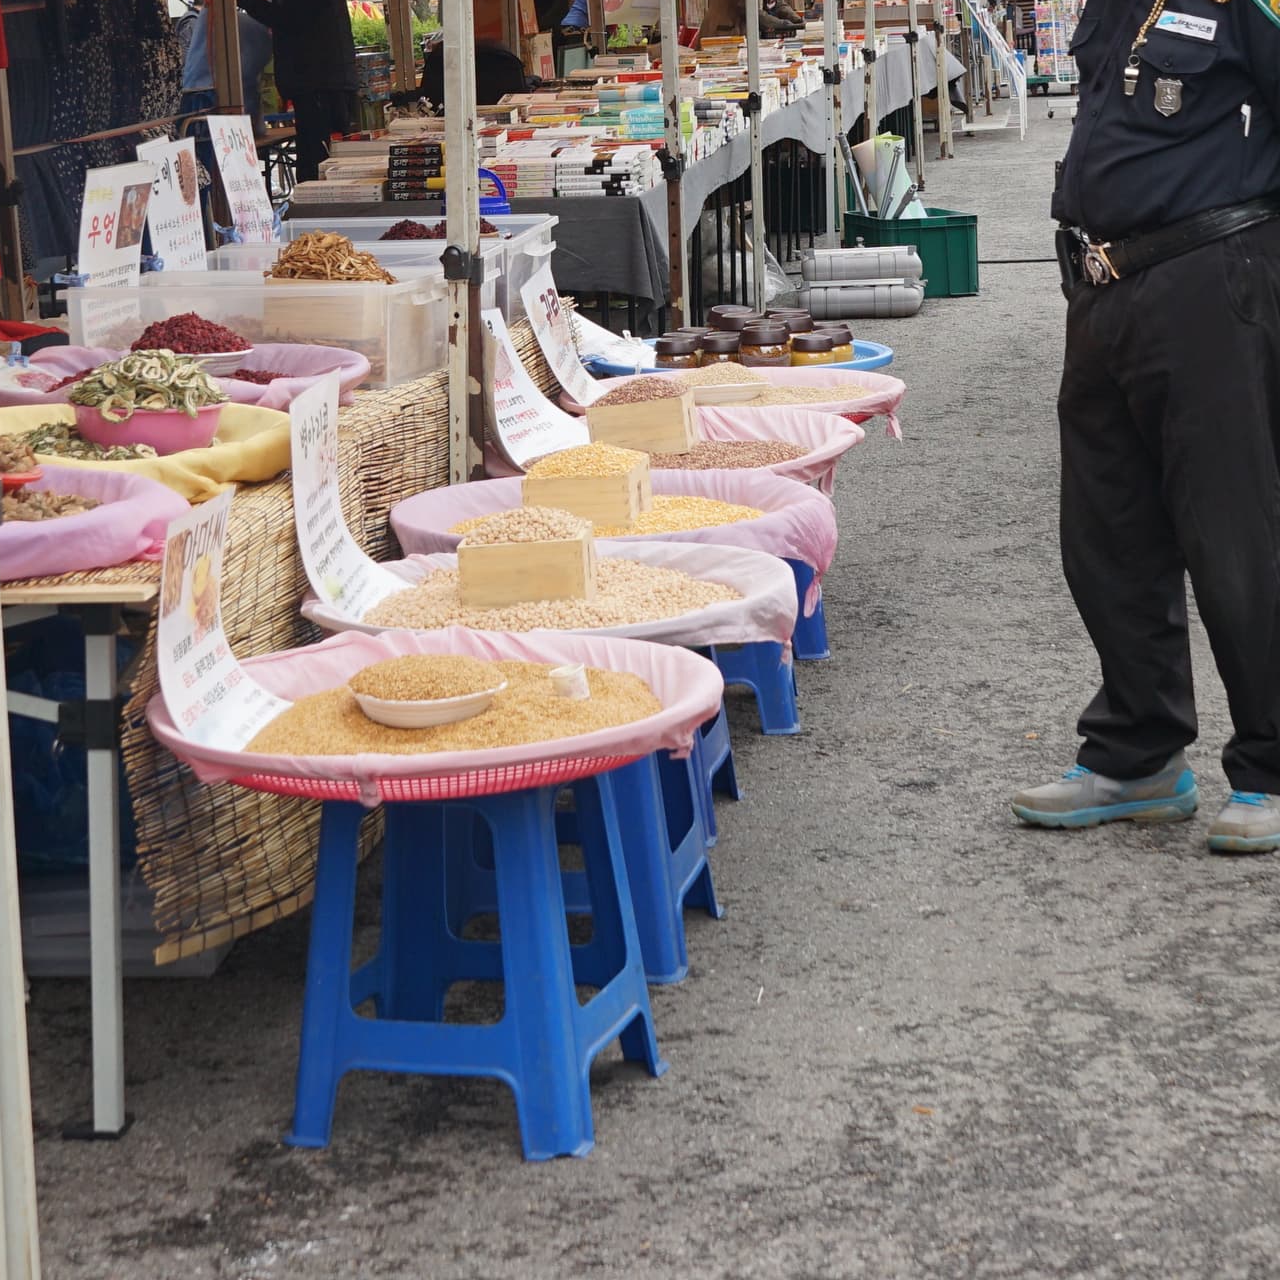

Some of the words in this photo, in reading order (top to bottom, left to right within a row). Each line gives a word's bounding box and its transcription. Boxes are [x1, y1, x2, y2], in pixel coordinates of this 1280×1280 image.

[88, 211, 117, 248] 우엉
[300, 402, 329, 458] 병아리콩
[182, 508, 228, 570] 아마씨
